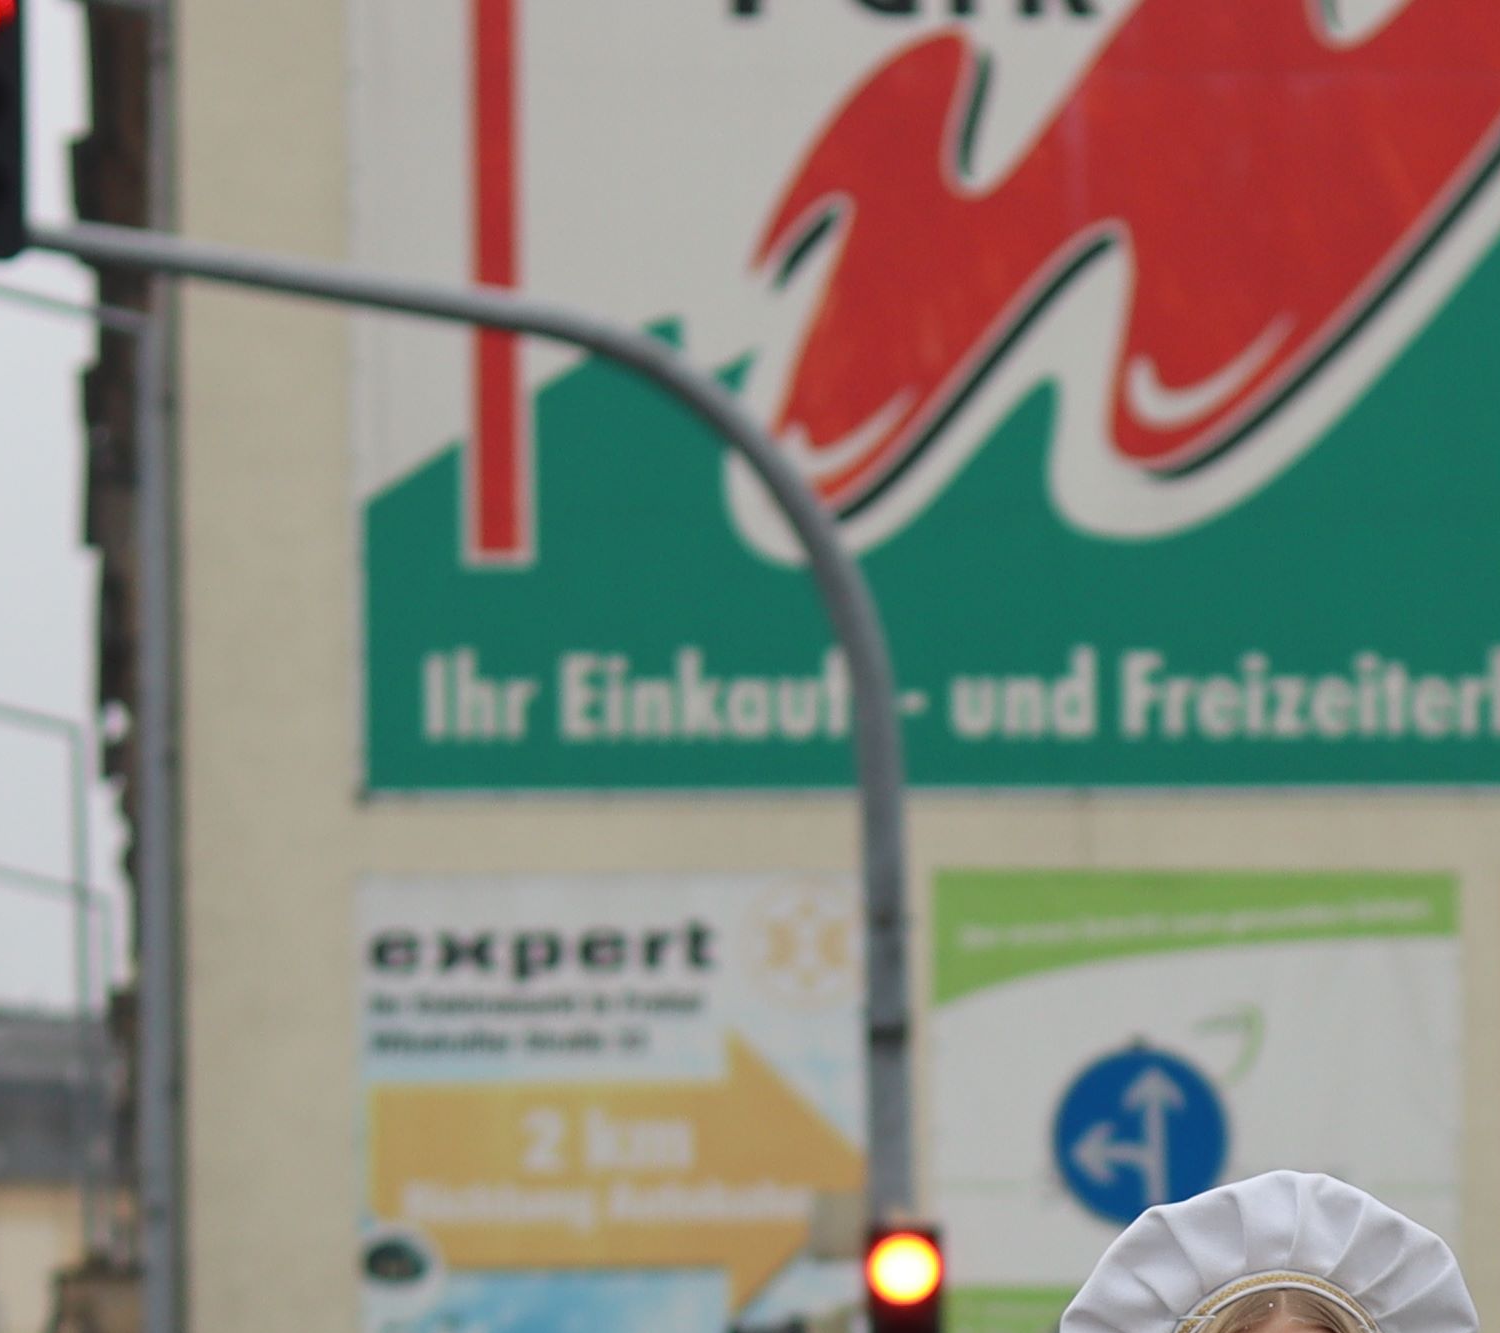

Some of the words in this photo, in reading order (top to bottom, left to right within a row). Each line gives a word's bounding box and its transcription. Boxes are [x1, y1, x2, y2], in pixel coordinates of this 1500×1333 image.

[423, 646, 538, 740] Ihr
[949, 645, 1095, 740] und
[370, 917, 715, 982] expert
[521, 1108, 563, 1173] 2
[583, 1107, 693, 1171] km
